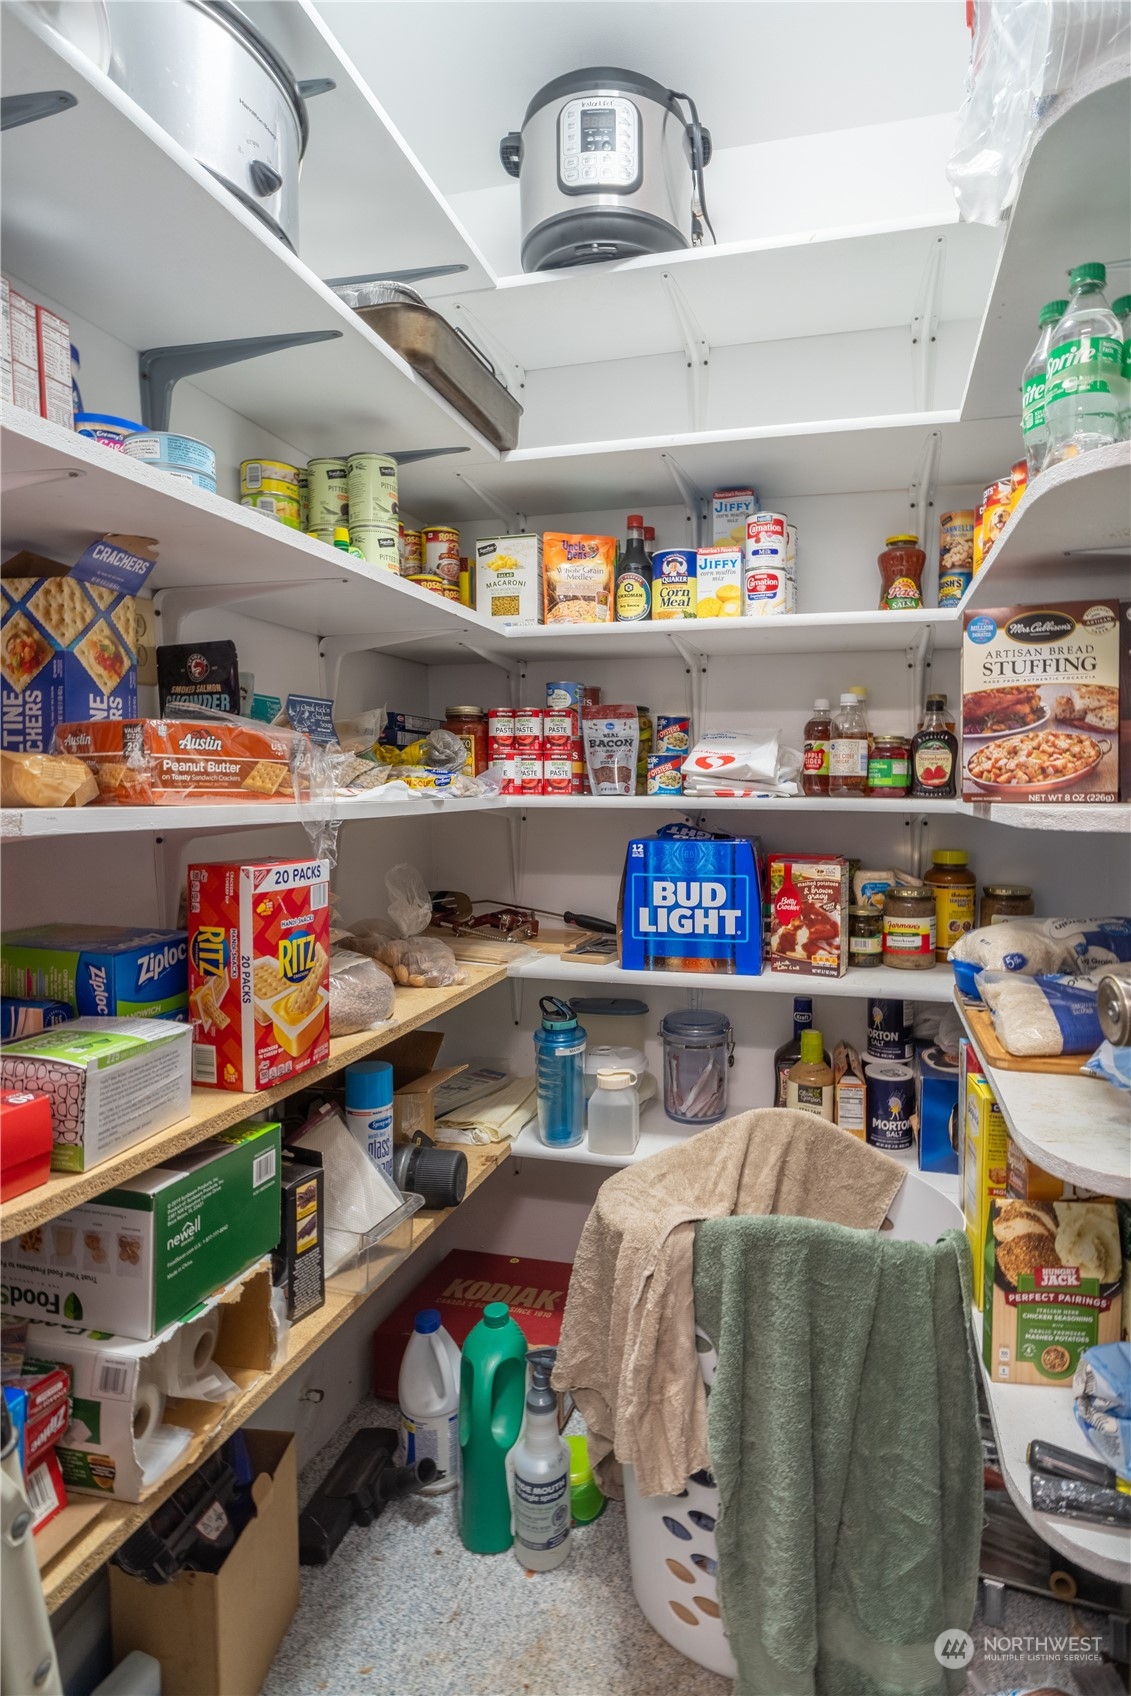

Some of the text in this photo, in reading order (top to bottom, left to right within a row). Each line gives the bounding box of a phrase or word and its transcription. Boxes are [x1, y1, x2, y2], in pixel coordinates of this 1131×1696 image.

[1047, 346, 1095, 378] Sprite
[1023, 383, 1045, 407] rite
[715, 502, 751, 513] JIFFY
[749, 522, 782, 536] Carnation
[562, 540, 586, 551] Uncle
[92, 545, 150, 575] CRACKERS
[566, 550, 587, 561] Ben's
[699, 558, 739, 570] JIFFY
[486, 579, 527, 589] MACARONI
[662, 576, 688, 584] QUAKER
[747, 578, 778, 589] Carnation
[659, 587, 690, 598] Corn
[888, 585, 920, 599] Pace
[660, 596, 691, 608] Meal
[892, 600, 916, 609] SALSA
[1086, 617, 1112, 625] ARTISAN
[985, 644, 1095, 660] ARTISAN BREAD
[982, 656, 1097, 677] STUFFING
[171, 683, 222, 694] SMOKED SALMON
[320, 720, 332, 731] Soup
[659, 724, 681, 738] OYSTERS
[64, 732, 91, 746] Austin
[179, 733, 222, 751] Austin
[588, 739, 634, 749] BACON
[271, 743, 287, 751] USA
[162, 760, 241, 774] Peanut Butter
[651, 763, 673, 776] OYSTERS
[171, 774, 191, 782] Toasty
[191, 774, 217, 782] Sandwich
[1072, 793, 1084, 801] OZ
[1086, 793, 1115, 802] (226g)
[275, 865, 321, 885] 20 PACKS
[653, 881, 727, 907] BUD
[811, 886, 833, 894] brown
[781, 897, 797, 905] Betty
[807, 894, 829, 903] gravy
[776, 903, 800, 911] Crocker
[639, 907, 741, 935] LIGHT
[887, 920, 921, 930] Farman's
[198, 926, 226, 977] RITZ
[278, 934, 316, 979] RITZ
[137, 943, 187, 986] Ziploc
[1006, 957, 1014, 968] 5
[242, 955, 251, 1004] 20 PACKS
[89, 965, 109, 1015] Ziploc
[796, 1013, 809, 1021] Kraft
[868, 1030, 899, 1042] ORTON
[871, 1038, 885, 1047] SALT
[258, 1044, 278, 1054] CRACKERS
[872, 1117, 911, 1130] MORTON
[886, 1130, 903, 1138] SALT
[368, 1138, 390, 1159] glass
[167, 1214, 201, 1251] newell
[1042, 1268, 1076, 1276] HUNGRY
[1041, 1274, 1079, 1286] JACK
[441, 1278, 563, 1311] KODIAK
[1008, 1293, 1107, 1308] PERFECT PAIRINGS
[510, 1306, 534, 1316] SINCE
[1022, 1313, 1093, 1323] CHICKEN SEASONING
[532, 1478, 566, 1495] MOUTH
